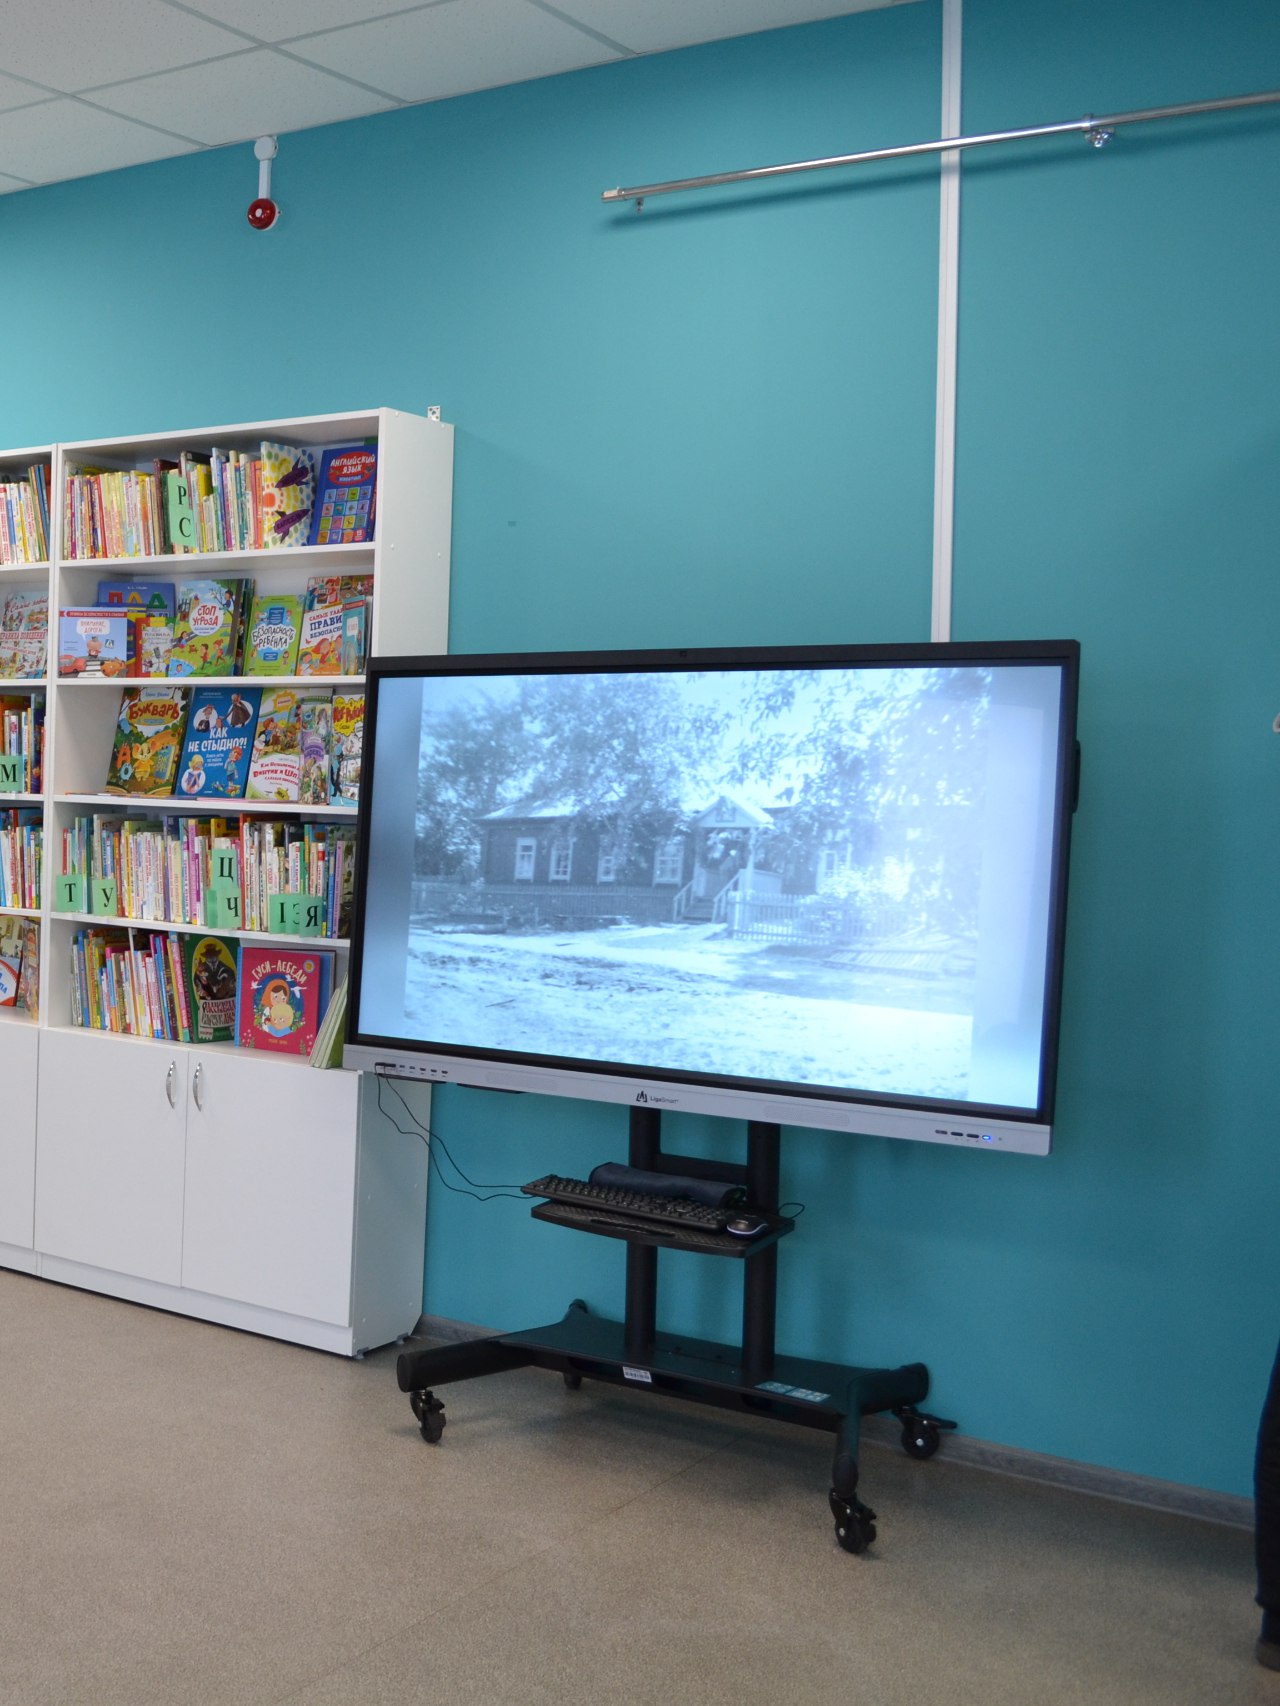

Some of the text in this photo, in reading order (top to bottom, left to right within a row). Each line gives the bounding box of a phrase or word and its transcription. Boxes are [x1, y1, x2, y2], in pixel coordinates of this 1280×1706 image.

[330, 453, 376, 467] АНГЛИЙСКИЙ
[342, 464, 363, 475] ЯЗЫК
[178, 485, 187, 505] Р
[179, 517, 192, 538] С
[197, 604, 217, 616] СТОП
[309, 611, 329, 622] САМЫХ
[192, 615, 219, 627] УГРОЗА
[310, 615, 343, 631] ПРАВИ
[252, 625, 295, 643] БЕЗОПАСНОСТЬ
[209, 727, 229, 739] КАК
[188, 741, 200, 752] НЕ
[0, 763, 19, 783] М
[219, 856, 234, 881] Ц
[64, 883, 76, 903] Т
[101, 887, 114, 907] У
[226, 897, 240, 917] Ч
[305, 904, 319, 928] Я
[251, 959, 308, 984] ГУСИ-ЛЕБЕДИ
